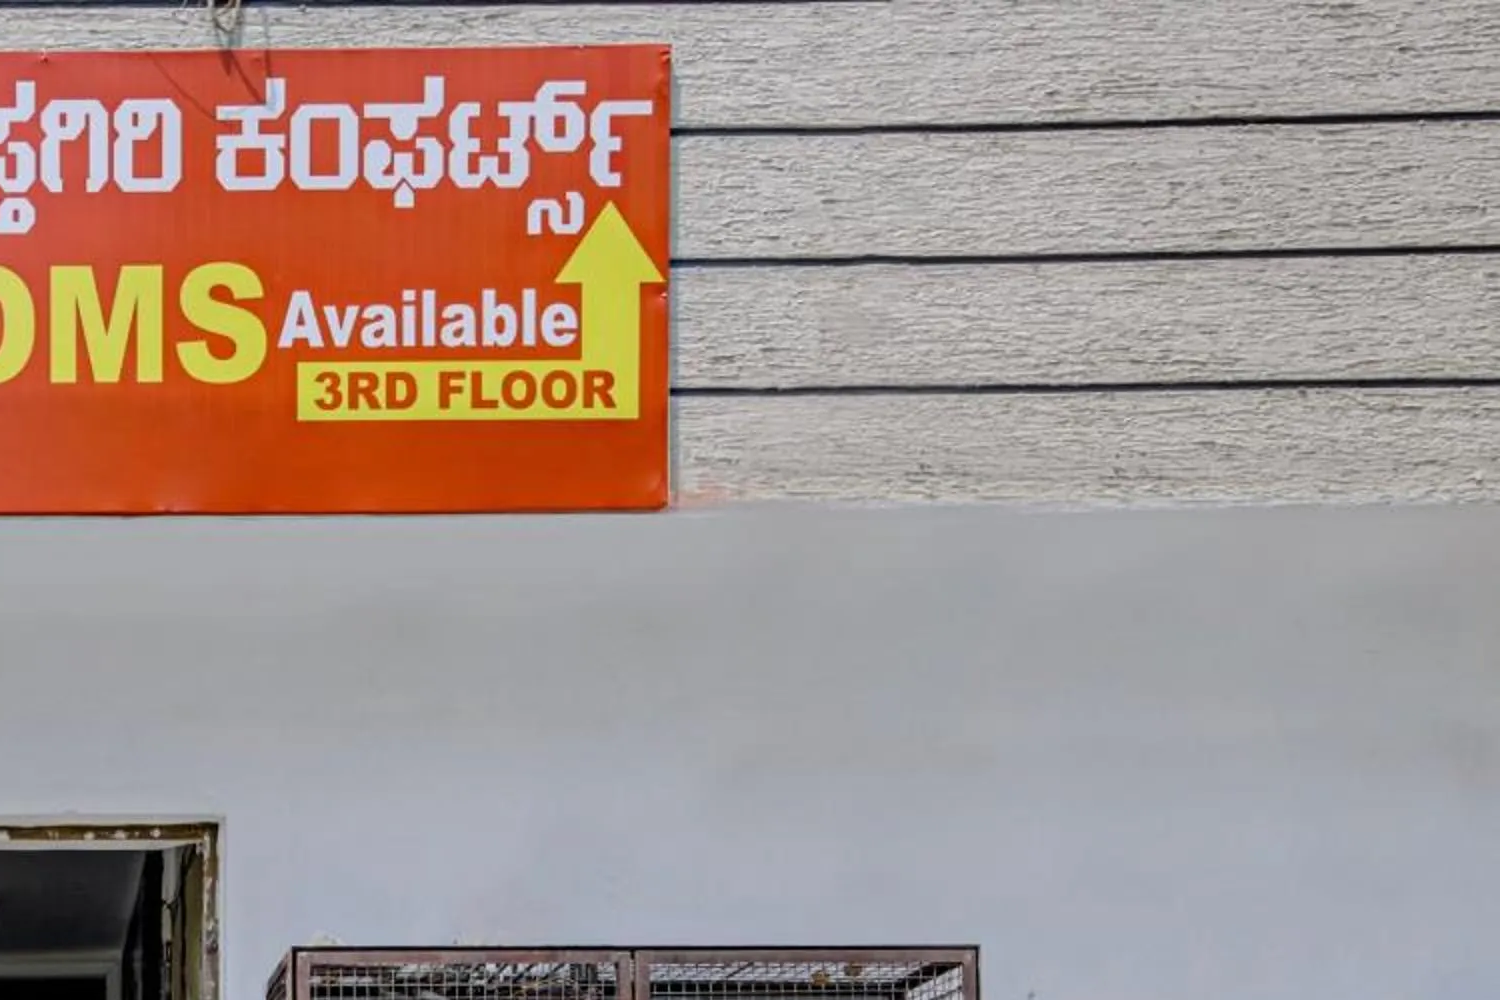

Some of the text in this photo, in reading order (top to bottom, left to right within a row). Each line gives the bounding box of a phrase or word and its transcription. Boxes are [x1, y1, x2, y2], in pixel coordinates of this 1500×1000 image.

[278, 289, 578, 348] Available
[314, 369, 617, 412] 3RD FLOOR
